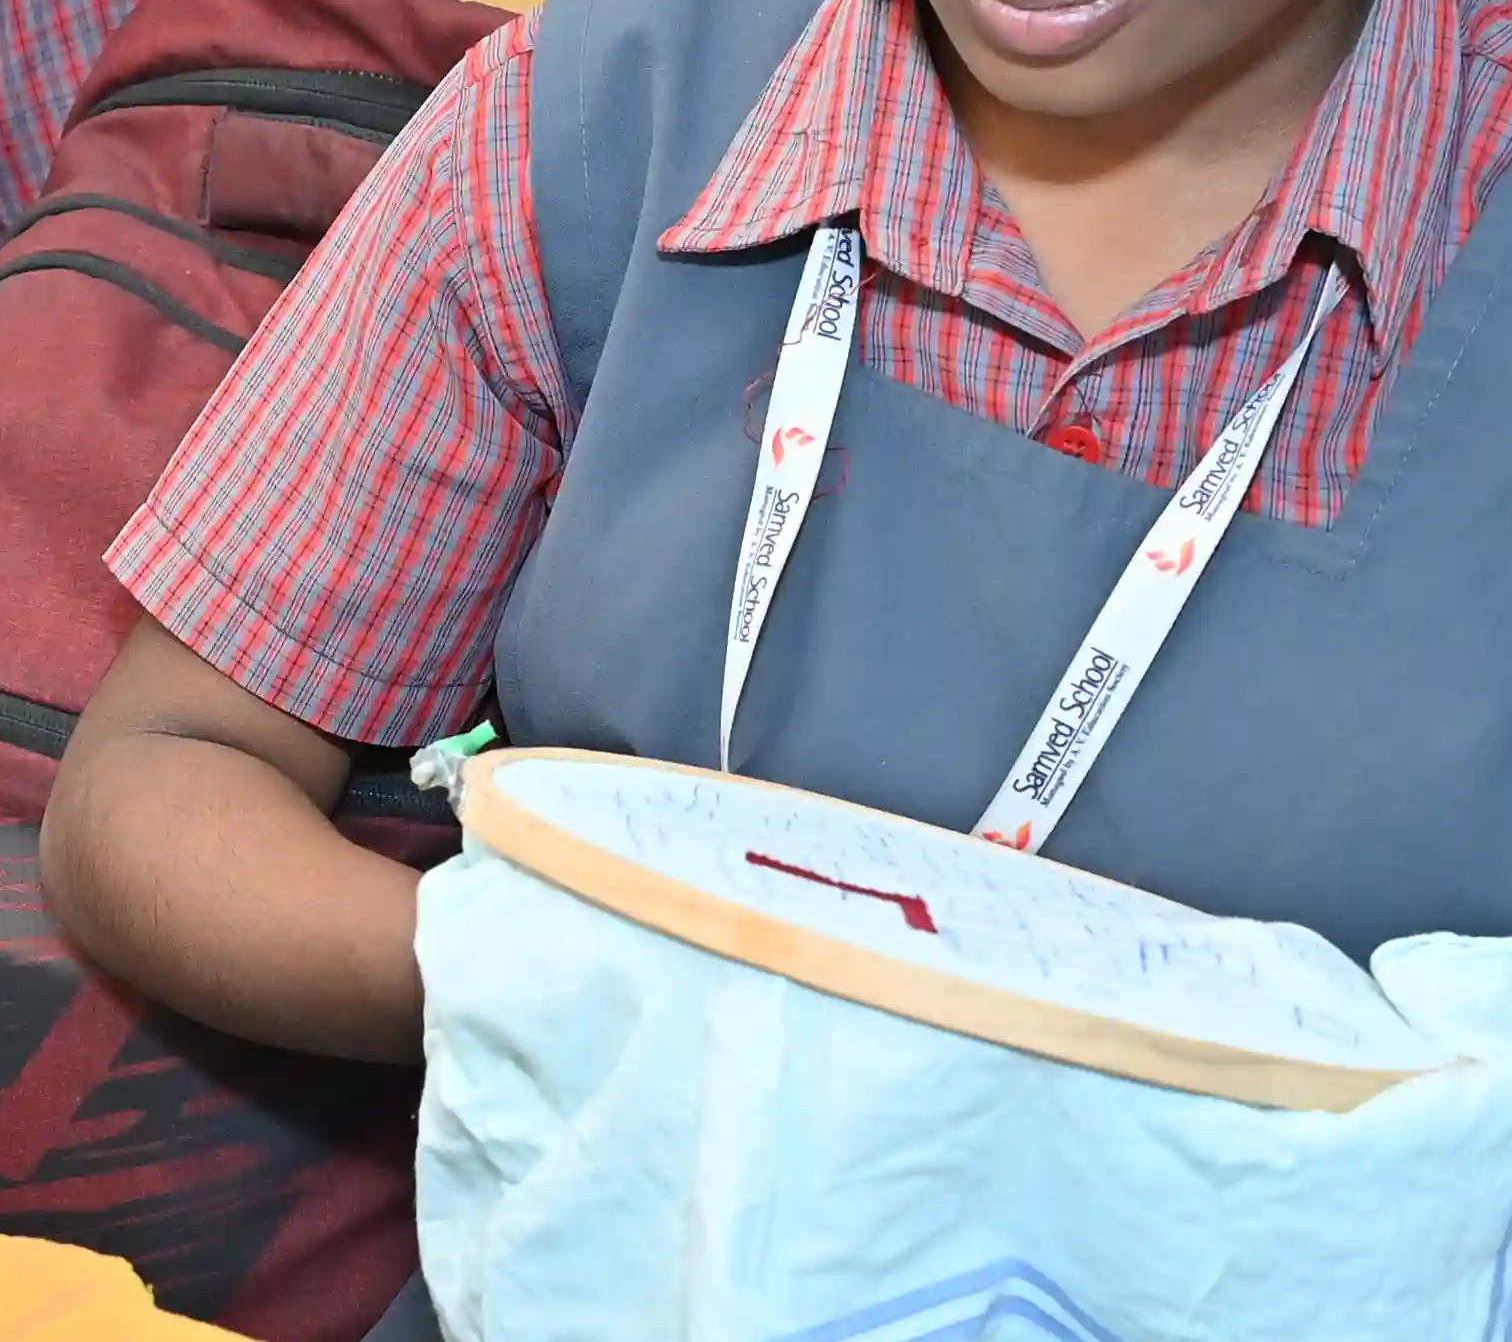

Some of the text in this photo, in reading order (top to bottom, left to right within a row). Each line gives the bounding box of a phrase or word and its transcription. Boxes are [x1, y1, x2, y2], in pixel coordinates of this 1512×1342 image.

[817, 227, 854, 340] ved School
[1178, 437, 1240, 515] Samved
[756, 490, 800, 566] Samved
[740, 576, 767, 642] School
[1011, 645, 1116, 801] Samved School
[1040, 767, 1070, 809] Managed
[1062, 756, 1076, 770] by
[1081, 691, 1112, 737] Education
[1106, 662, 1132, 695] Society
